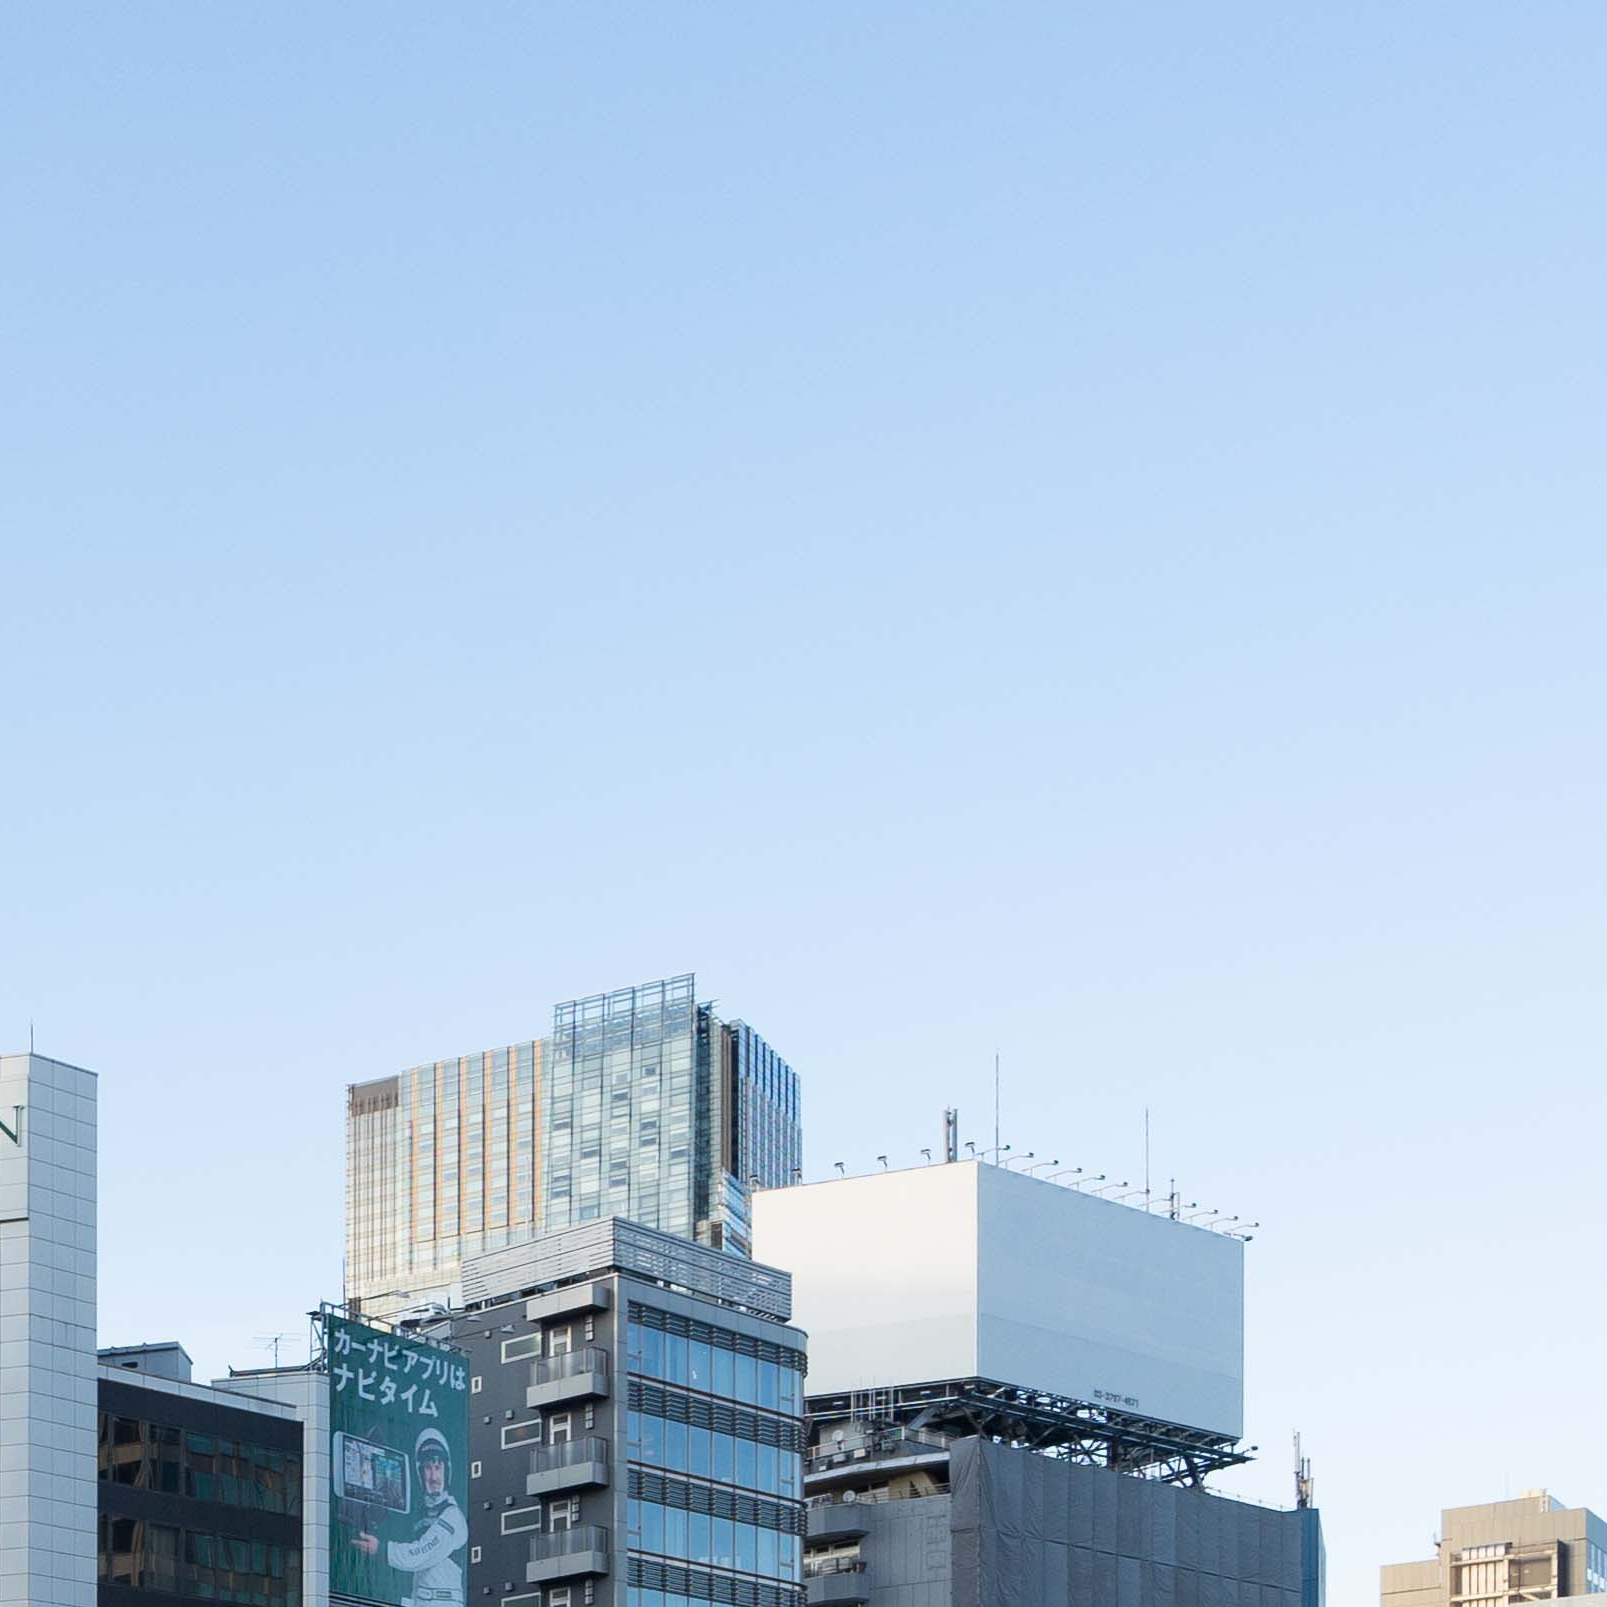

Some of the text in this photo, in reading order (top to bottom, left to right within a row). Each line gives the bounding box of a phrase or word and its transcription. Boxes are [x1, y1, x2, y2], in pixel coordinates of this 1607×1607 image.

[334, 1327, 467, 1392] カーナビアプリは
[333, 1362, 438, 1418] ナビタイム
